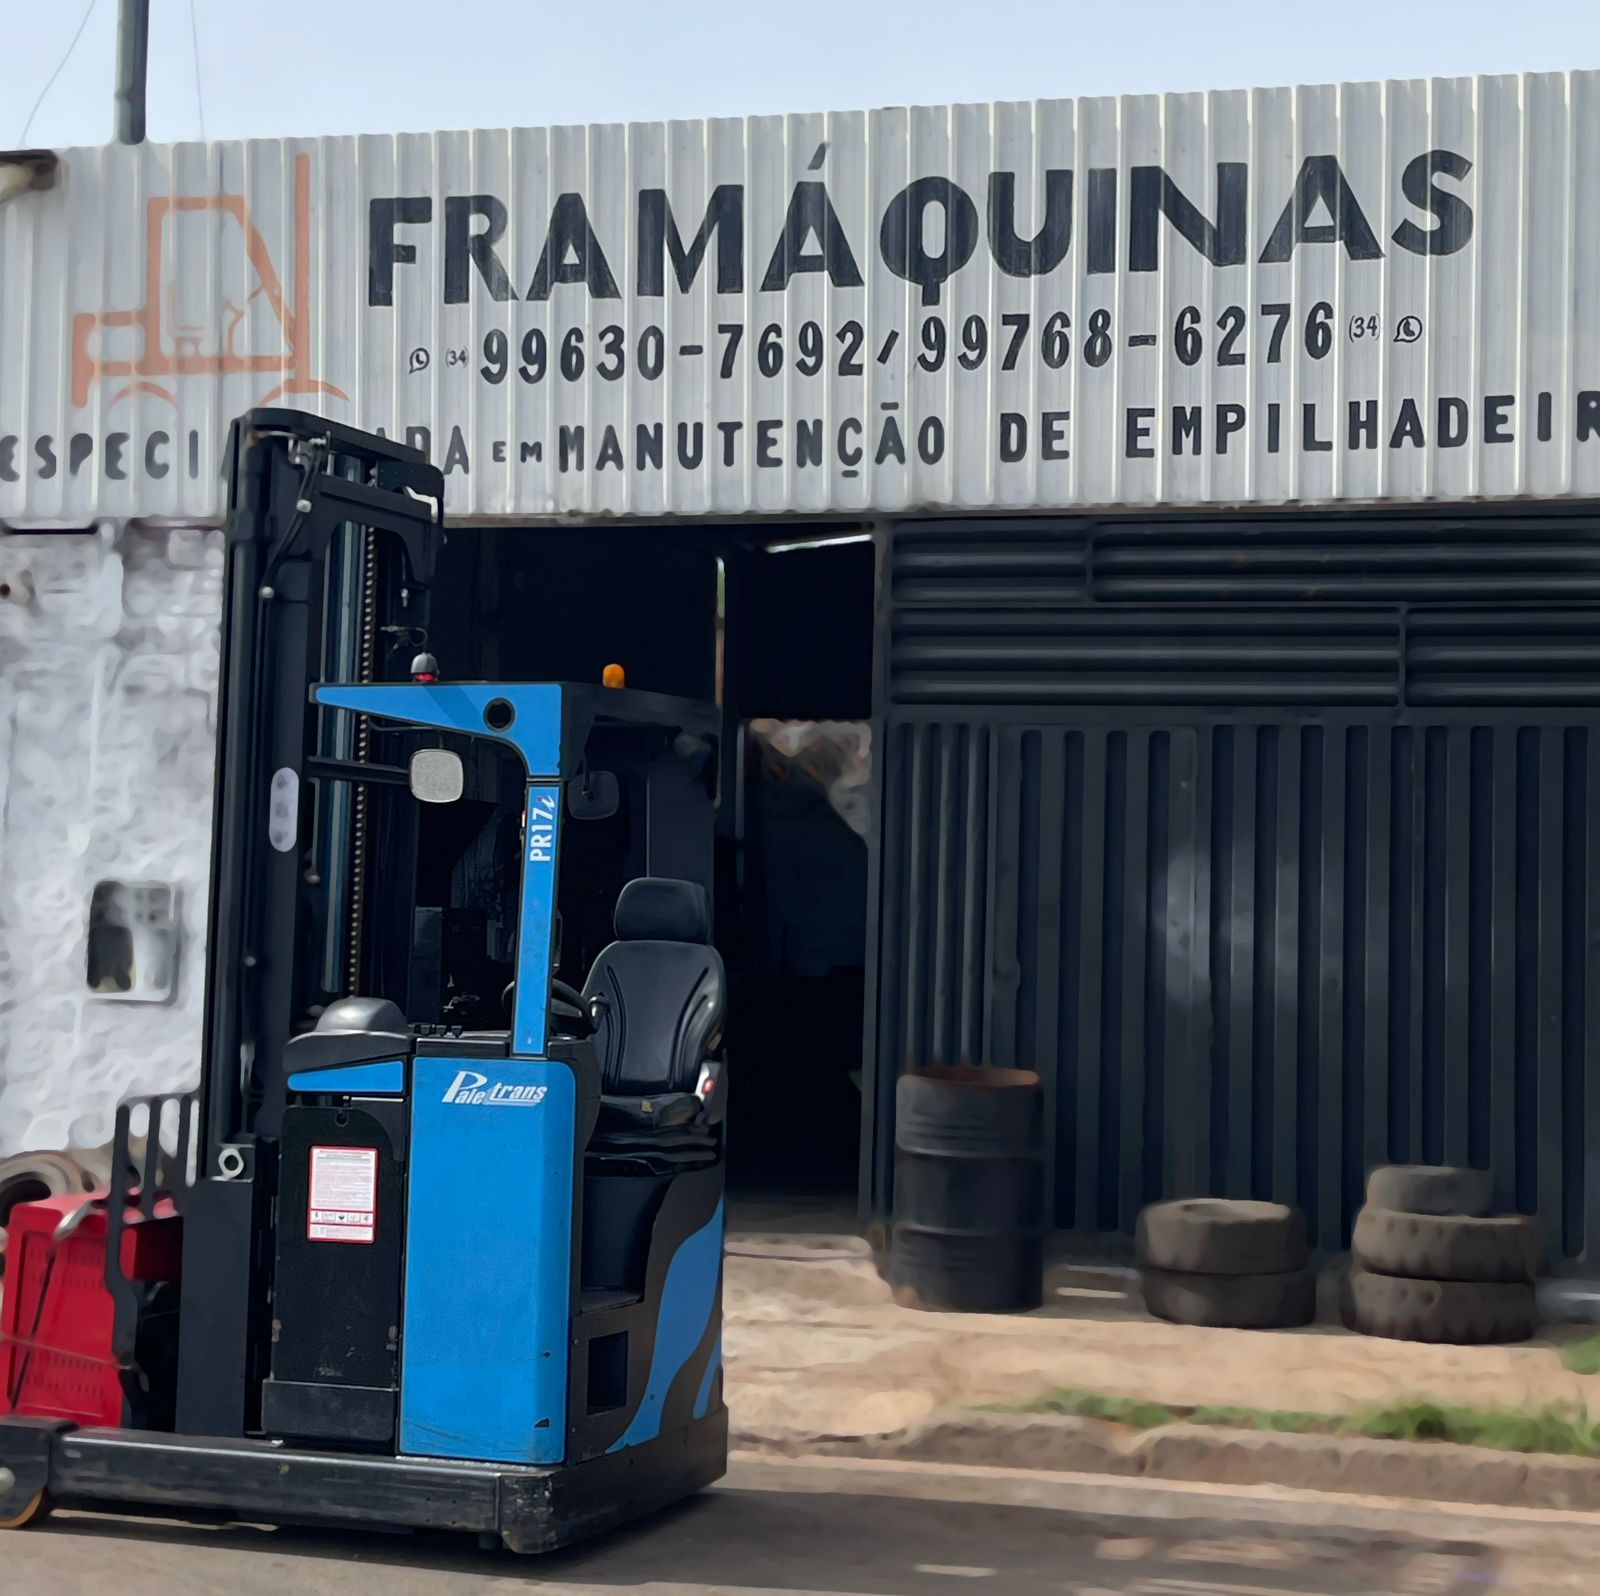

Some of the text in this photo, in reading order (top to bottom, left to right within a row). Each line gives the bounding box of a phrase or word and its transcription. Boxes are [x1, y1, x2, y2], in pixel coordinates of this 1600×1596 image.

[369, 142, 1473, 306] FRAMÁQUINAS
[445, 345, 469, 369] (34)
[1348, 312, 1380, 342] (34)
[493, 440, 542, 463] EM
[559, 402, 946, 477] MANUTENÇÃO
[1001, 411, 1071, 462] DE
[441, 1070, 547, 1105] Paletrans
